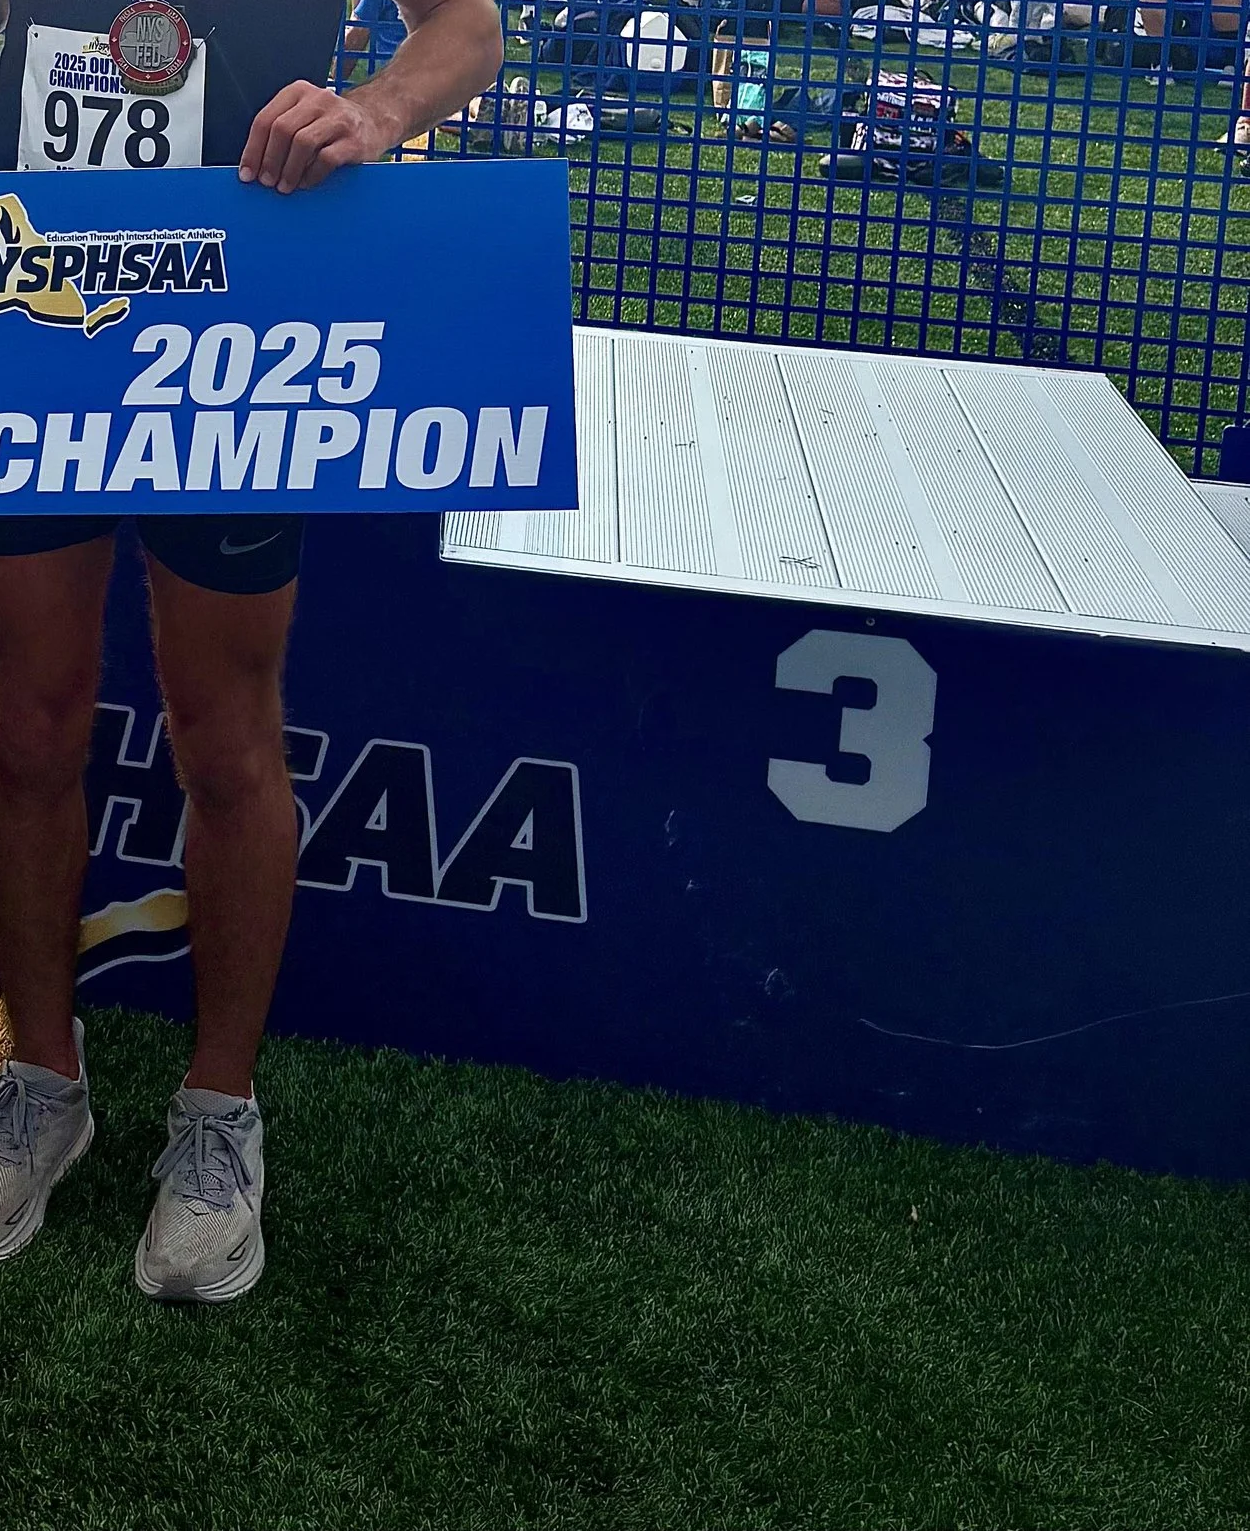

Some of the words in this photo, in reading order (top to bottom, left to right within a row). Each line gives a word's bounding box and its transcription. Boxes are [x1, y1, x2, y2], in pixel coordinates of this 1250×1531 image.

[137, 16, 163, 42] NYS
[54, 52, 87, 71] 2025
[136, 43, 161, 68] FED
[43, 90, 171, 168] 978
[46, 232, 88, 242] Education
[88, 232, 125, 242] Through
[126, 231, 186, 241] Interscholastic
[187, 230, 224, 239] Athletics
[122, 321, 385, 406] 2025
[767, 628, 938, 833] 3
